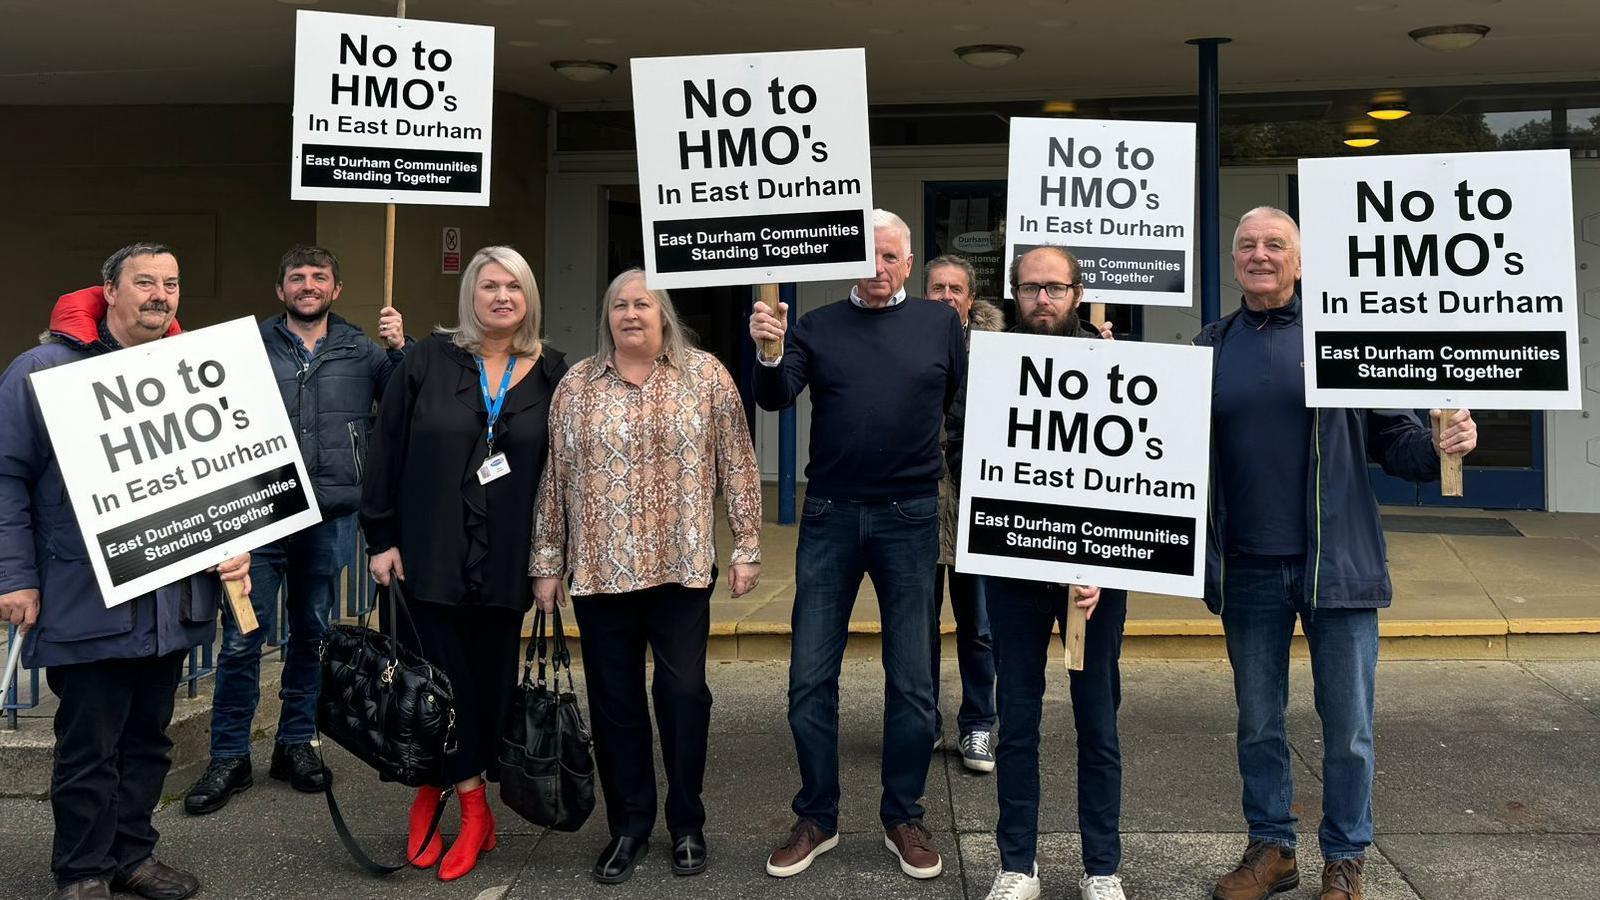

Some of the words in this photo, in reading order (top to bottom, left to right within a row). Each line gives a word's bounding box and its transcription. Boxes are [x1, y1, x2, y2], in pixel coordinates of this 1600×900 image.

[340, 33, 397, 68] No
[412, 40, 452, 72] to
[331, 73, 457, 112] HMO's
[683, 78, 752, 119] No
[768, 77, 817, 115] to
[309, 114, 329, 132] In
[338, 115, 388, 135] East
[396, 119, 482, 140] Durham
[306, 155, 335, 166] East
[339, 156, 390, 168] Durham
[394, 159, 477, 172] Communities
[678, 124, 828, 170] HMO's
[1048, 137, 1102, 169] No
[1115, 140, 1154, 170] to
[333, 169, 391, 184] Standing
[395, 172, 452, 185] Together
[658, 184, 681, 205] In
[691, 180, 750, 203] East
[757, 176, 861, 199] Durham
[1040, 175, 1159, 210] HMO's
[1357, 180, 1435, 223] No
[1454, 179, 1512, 221] to
[659, 233, 692, 246] East
[697, 230, 755, 244] Durham
[761, 225, 859, 240] Communities
[1020, 215, 1038, 232] In
[1046, 216, 1093, 234] East
[1100, 218, 1184, 238] Durham
[692, 246, 758, 260] Standing
[762, 242, 829, 258] Together
[1098, 258, 1180, 271] Communities
[1348, 233, 1524, 277] HMO's
[1099, 271, 1155, 284] Together
[1322, 291, 1348, 314] In
[1360, 291, 1428, 314] East
[1439, 290, 1563, 314] Durham
[1321, 346, 1359, 359] East
[1365, 346, 1434, 360] Durham
[1440, 346, 1560, 360] Communities
[92, 375, 165, 421] No
[177, 359, 225, 394] to
[1019, 355, 1089, 401] No
[1107, 364, 1158, 406] to
[1358, 364, 1437, 381] Standing
[1442, 364, 1523, 382] Together
[100, 396, 250, 473] HMO's
[1007, 407, 1163, 460] HMO's
[92, 494, 120, 515] In
[126, 466, 188, 503] East
[191, 435, 287, 480] Durham
[980, 458, 1003, 482] In
[1014, 461, 1075, 489] East
[1084, 468, 1195, 500] Durham
[106, 534, 144, 558] East
[144, 513, 205, 543] Durham
[207, 479, 296, 519] Communities
[144, 528, 212, 561] Standing
[212, 503, 274, 533] Together
[975, 511, 1009, 527] East
[1014, 515, 1076, 534] Durham
[1081, 522, 1189, 545] Communities
[1006, 532, 1077, 555] Standing
[1082, 539, 1154, 559] Together
